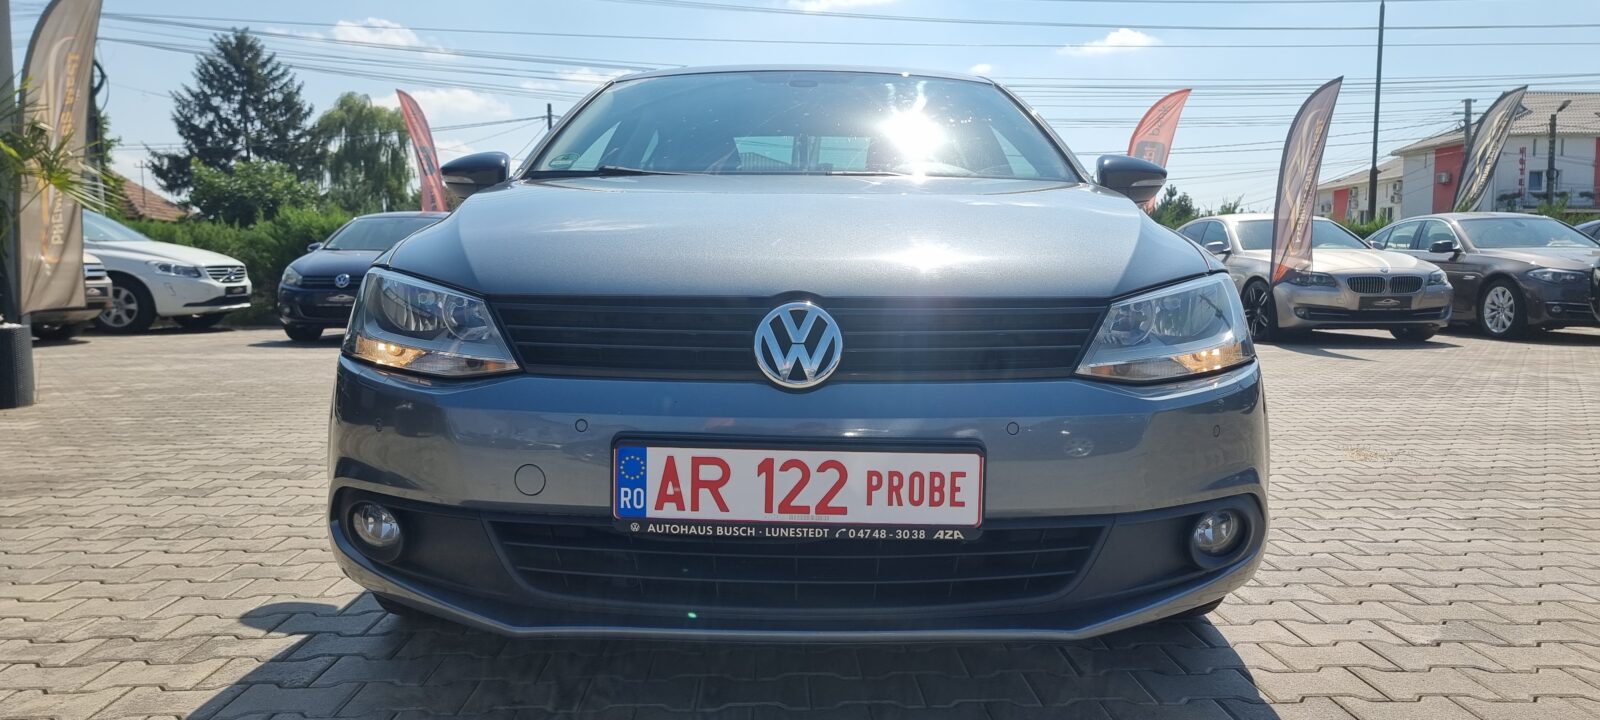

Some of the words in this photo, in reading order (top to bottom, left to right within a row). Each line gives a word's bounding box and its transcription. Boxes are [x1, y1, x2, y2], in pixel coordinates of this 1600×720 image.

[654, 455, 731, 512] AR
[757, 458, 848, 515] 122
[866, 470, 967, 507] PROBE
[620, 488, 644, 509] RO
[647, 523, 713, 535] AUTOHAUS
[716, 526, 755, 536] BUSCH
[765, 528, 830, 538] LUNESTEDT
[933, 530, 965, 540] AZA
